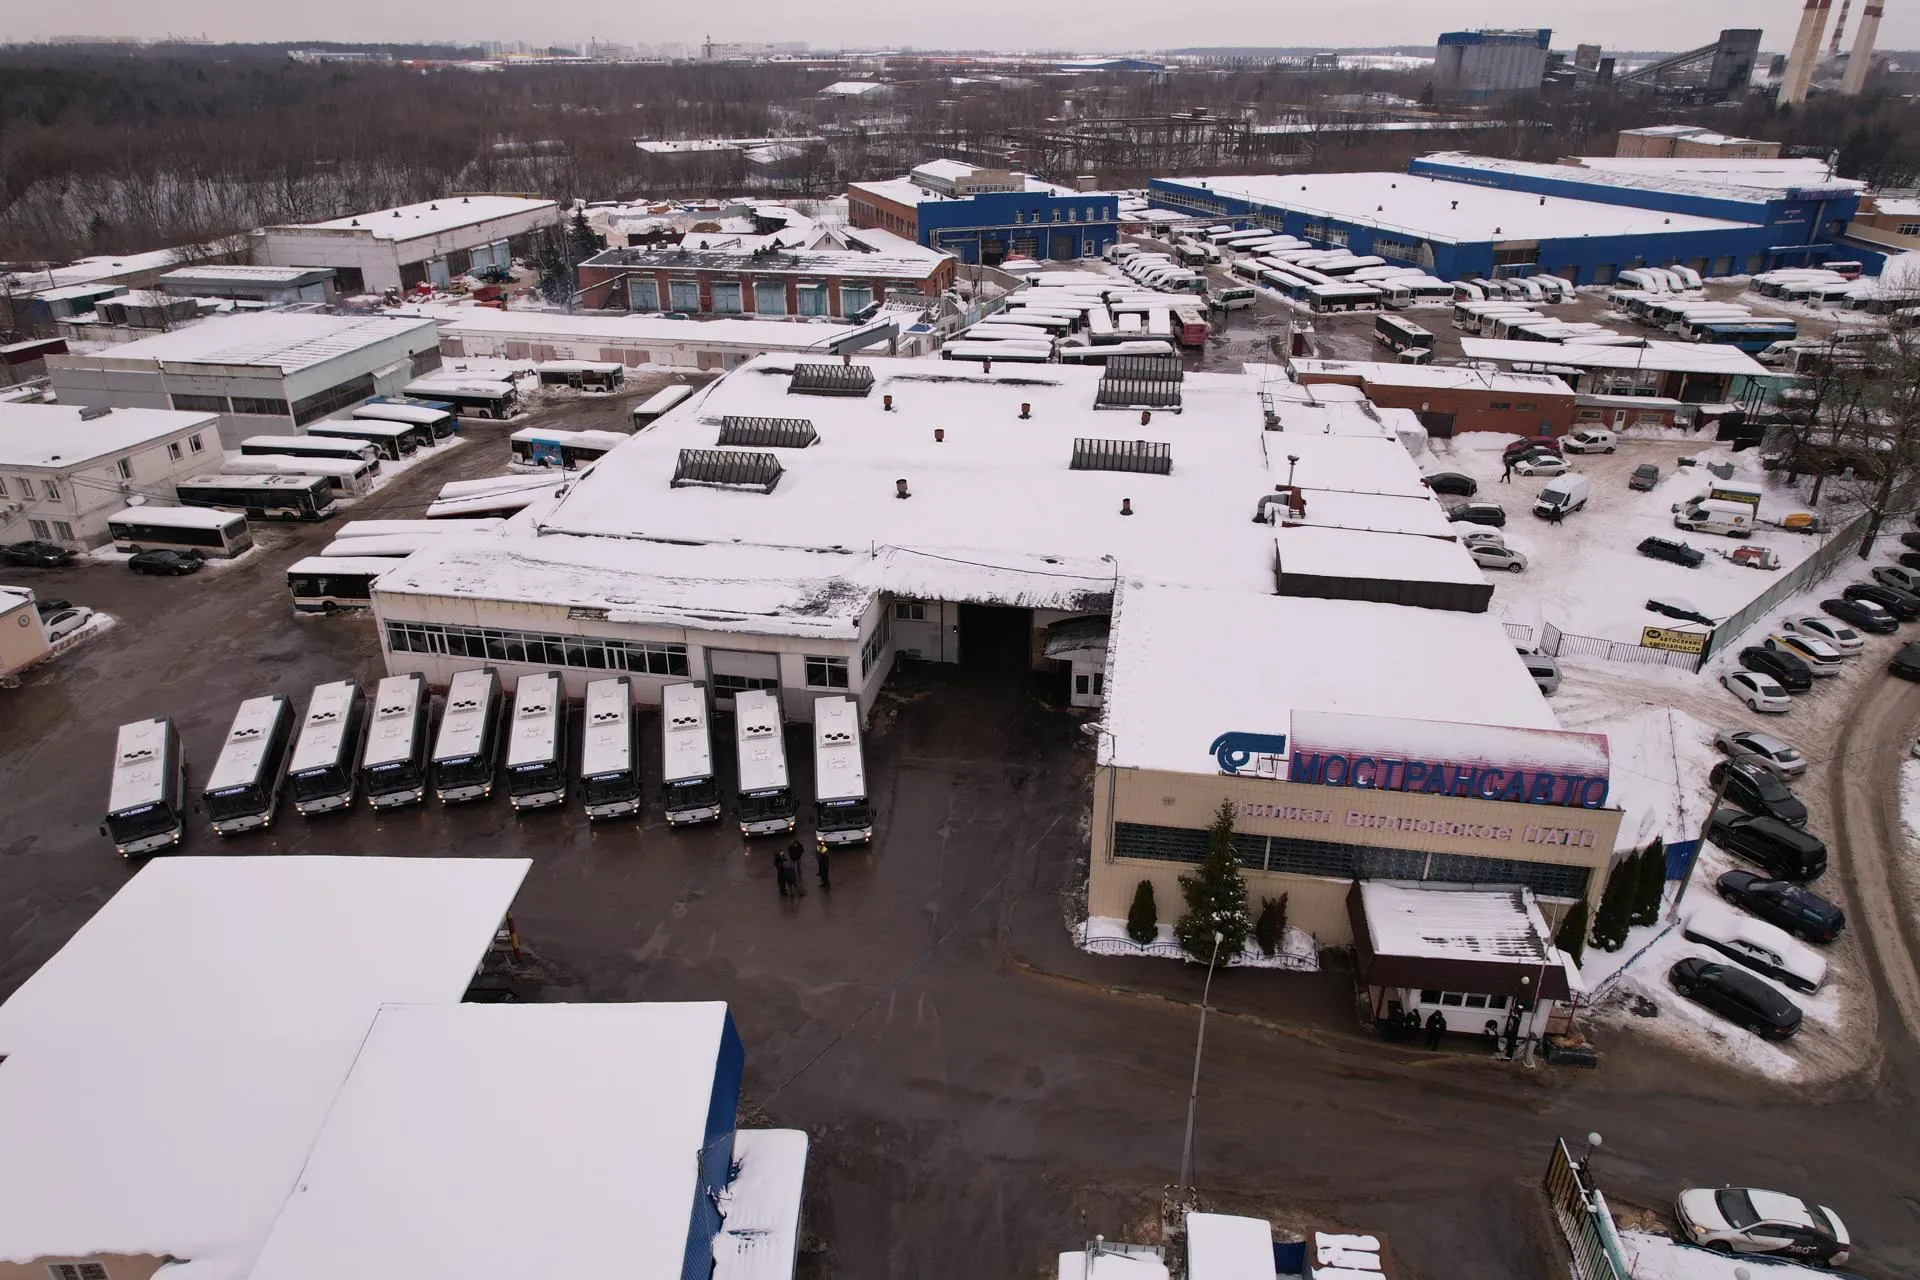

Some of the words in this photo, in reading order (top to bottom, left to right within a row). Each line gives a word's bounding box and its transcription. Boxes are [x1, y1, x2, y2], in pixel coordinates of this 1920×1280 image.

[1648, 641, 1701, 651] АВТОЗАПЧАСТИ
[1660, 637, 1702, 646] АВТОСЕРВИС
[1290, 750, 1609, 810] МОСТРАНСАВТО
[1345, 809, 1512, 841] Видновское
[1522, 825, 1600, 848] ПАТП
